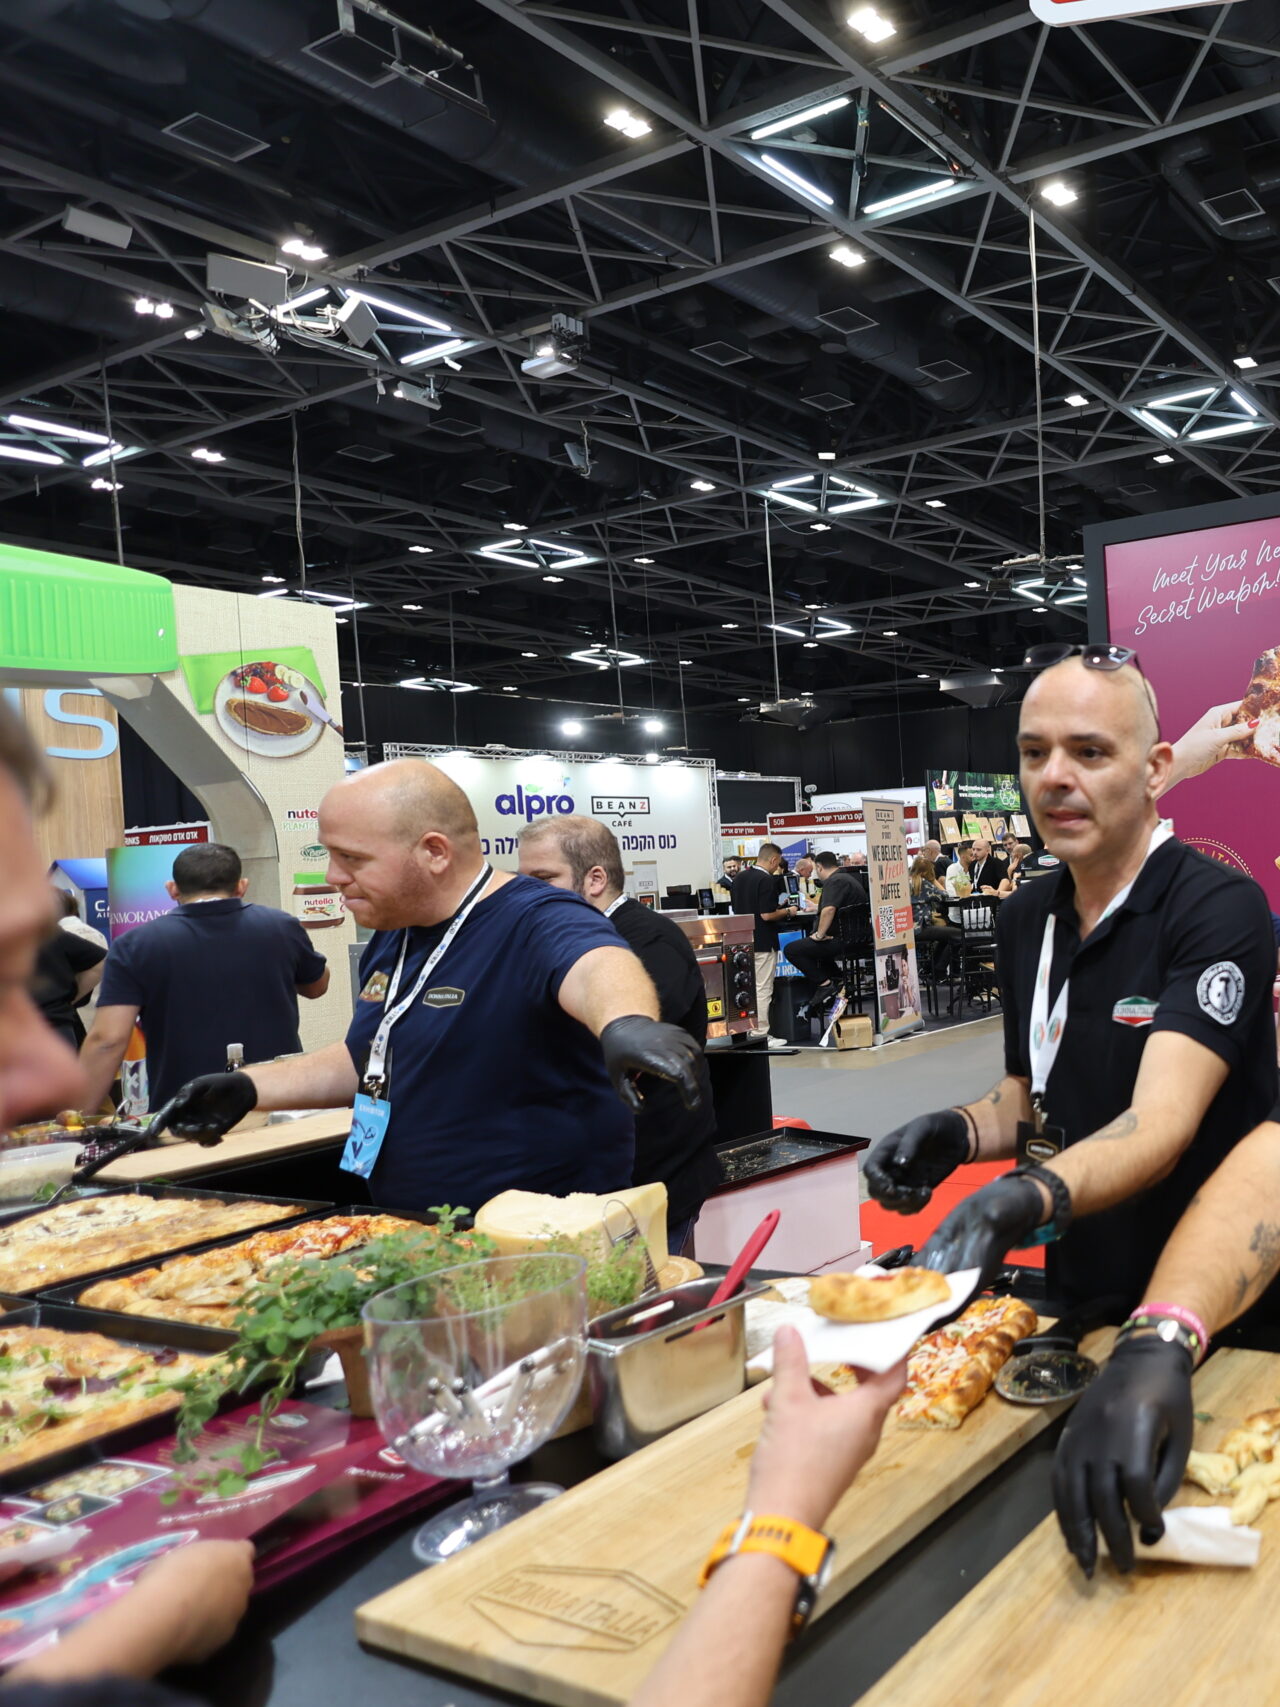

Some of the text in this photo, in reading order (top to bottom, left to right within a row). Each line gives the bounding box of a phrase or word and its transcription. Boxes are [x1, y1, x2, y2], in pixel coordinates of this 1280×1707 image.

[1201, 548, 1248, 581] Your
[1134, 588, 1195, 636] Secret
[495, 783, 575, 823] alpro
[596, 801, 647, 810] BEANZ
[287, 808, 319, 819] nute
[611, 819, 633, 828] CAFÉ
[773, 817, 785, 827] 508
[622, 834, 656, 852] הקפה
[658, 834, 677, 849] כוס
[881, 844, 903, 862] BELIEVE
[880, 882, 901, 900] COFFEE
[304, 897, 334, 906] nutella
